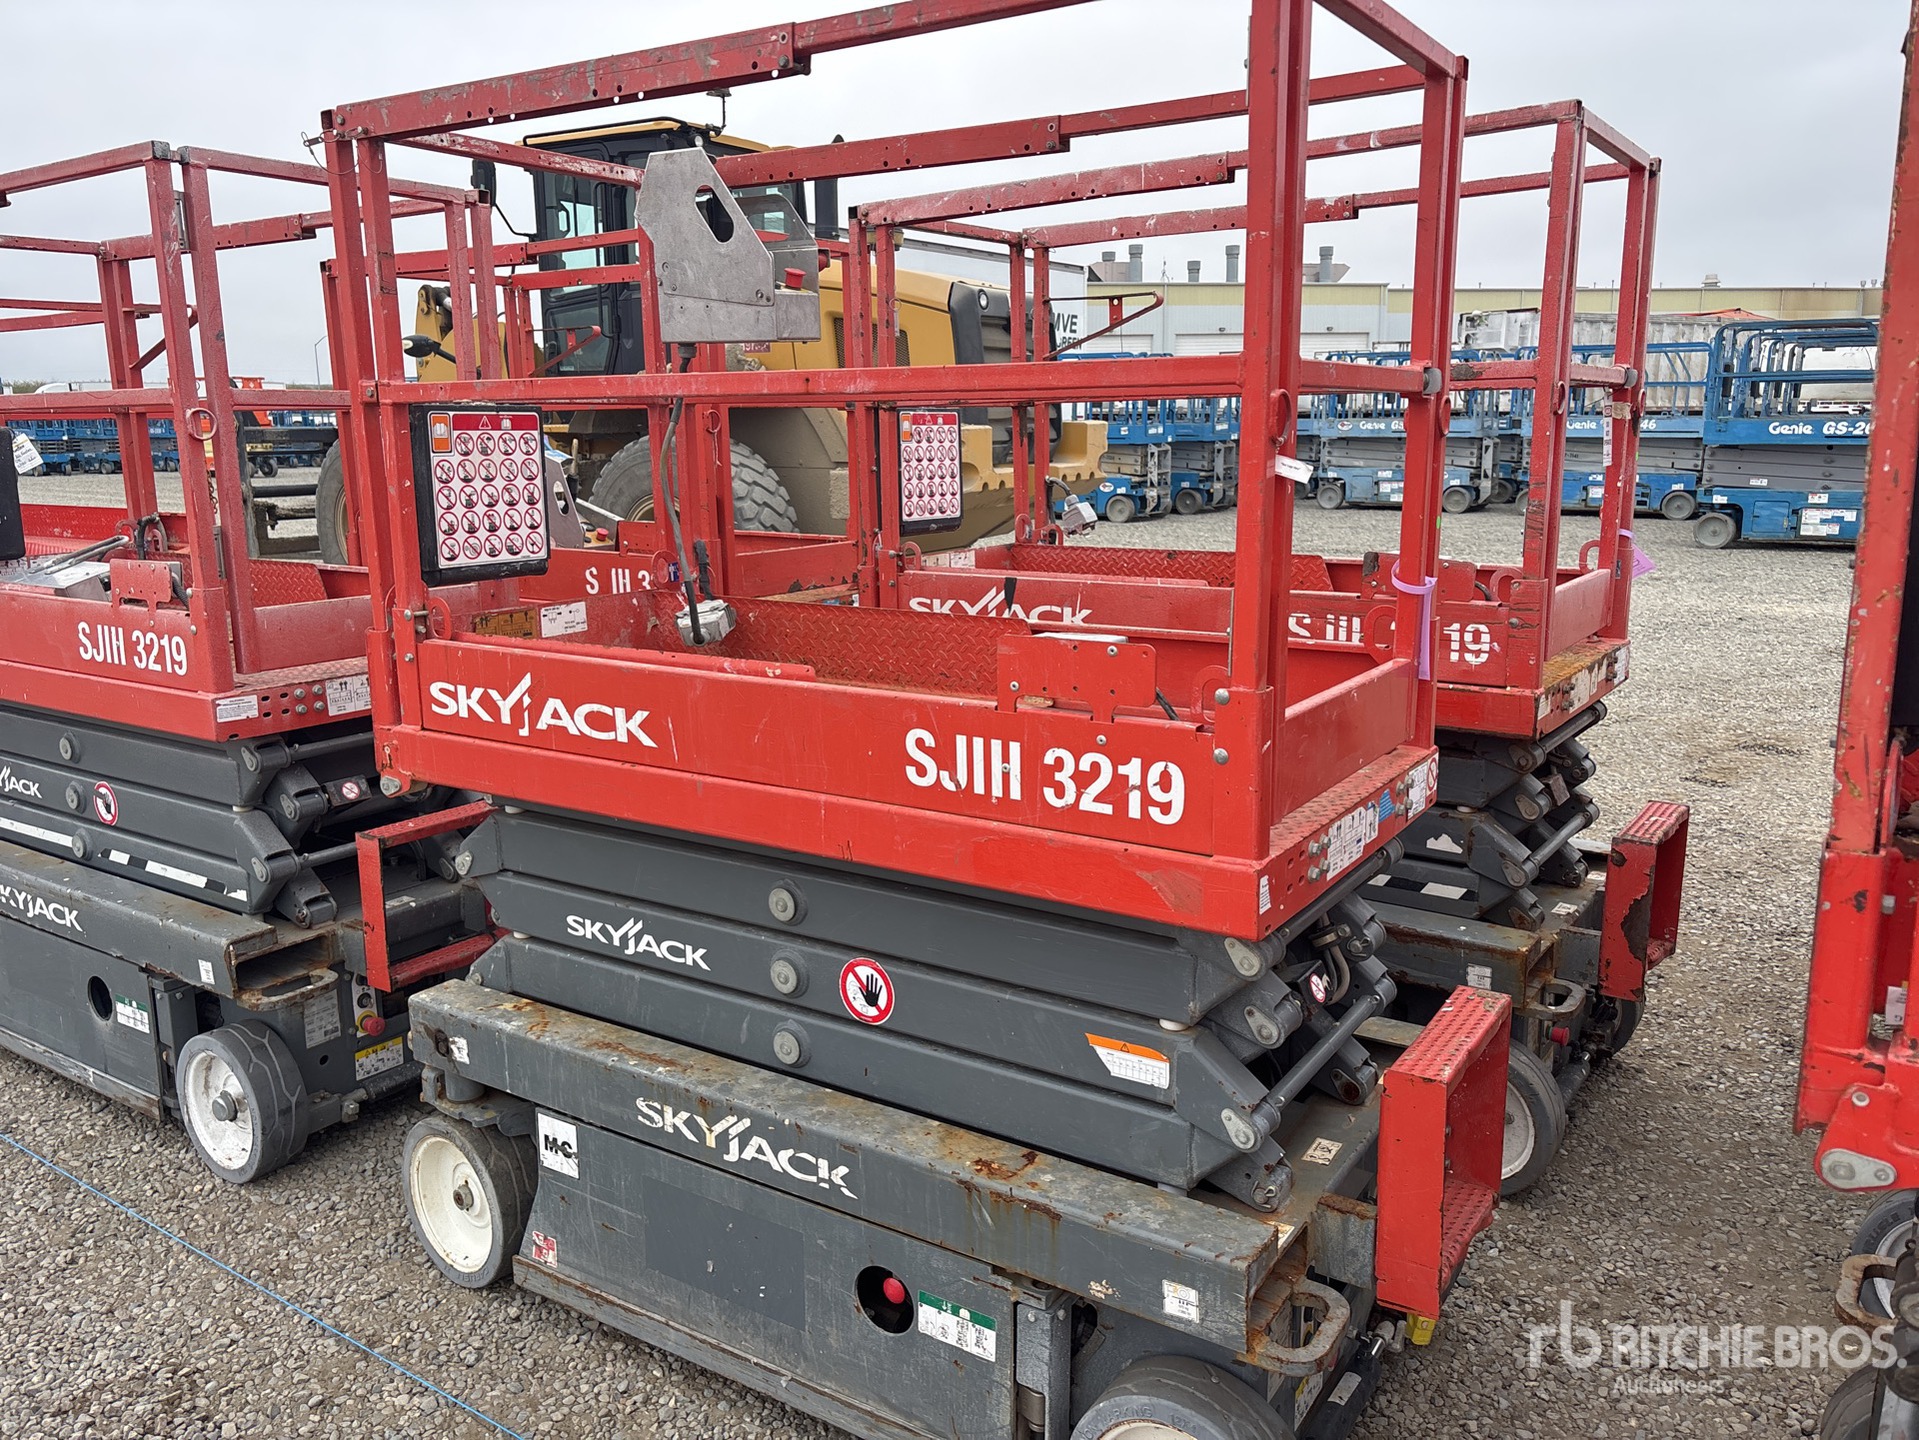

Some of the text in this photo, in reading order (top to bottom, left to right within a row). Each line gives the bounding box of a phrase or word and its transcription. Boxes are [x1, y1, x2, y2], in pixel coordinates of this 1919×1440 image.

[1768, 421, 1814, 435] Genie
[131, 629, 188, 676] 3219
[429, 671, 659, 749] SKYJACK
[1042, 747, 1186, 826] 3219
[566, 913, 711, 972] SKYJACK
[634, 1096, 859, 1200] SKYJACK
